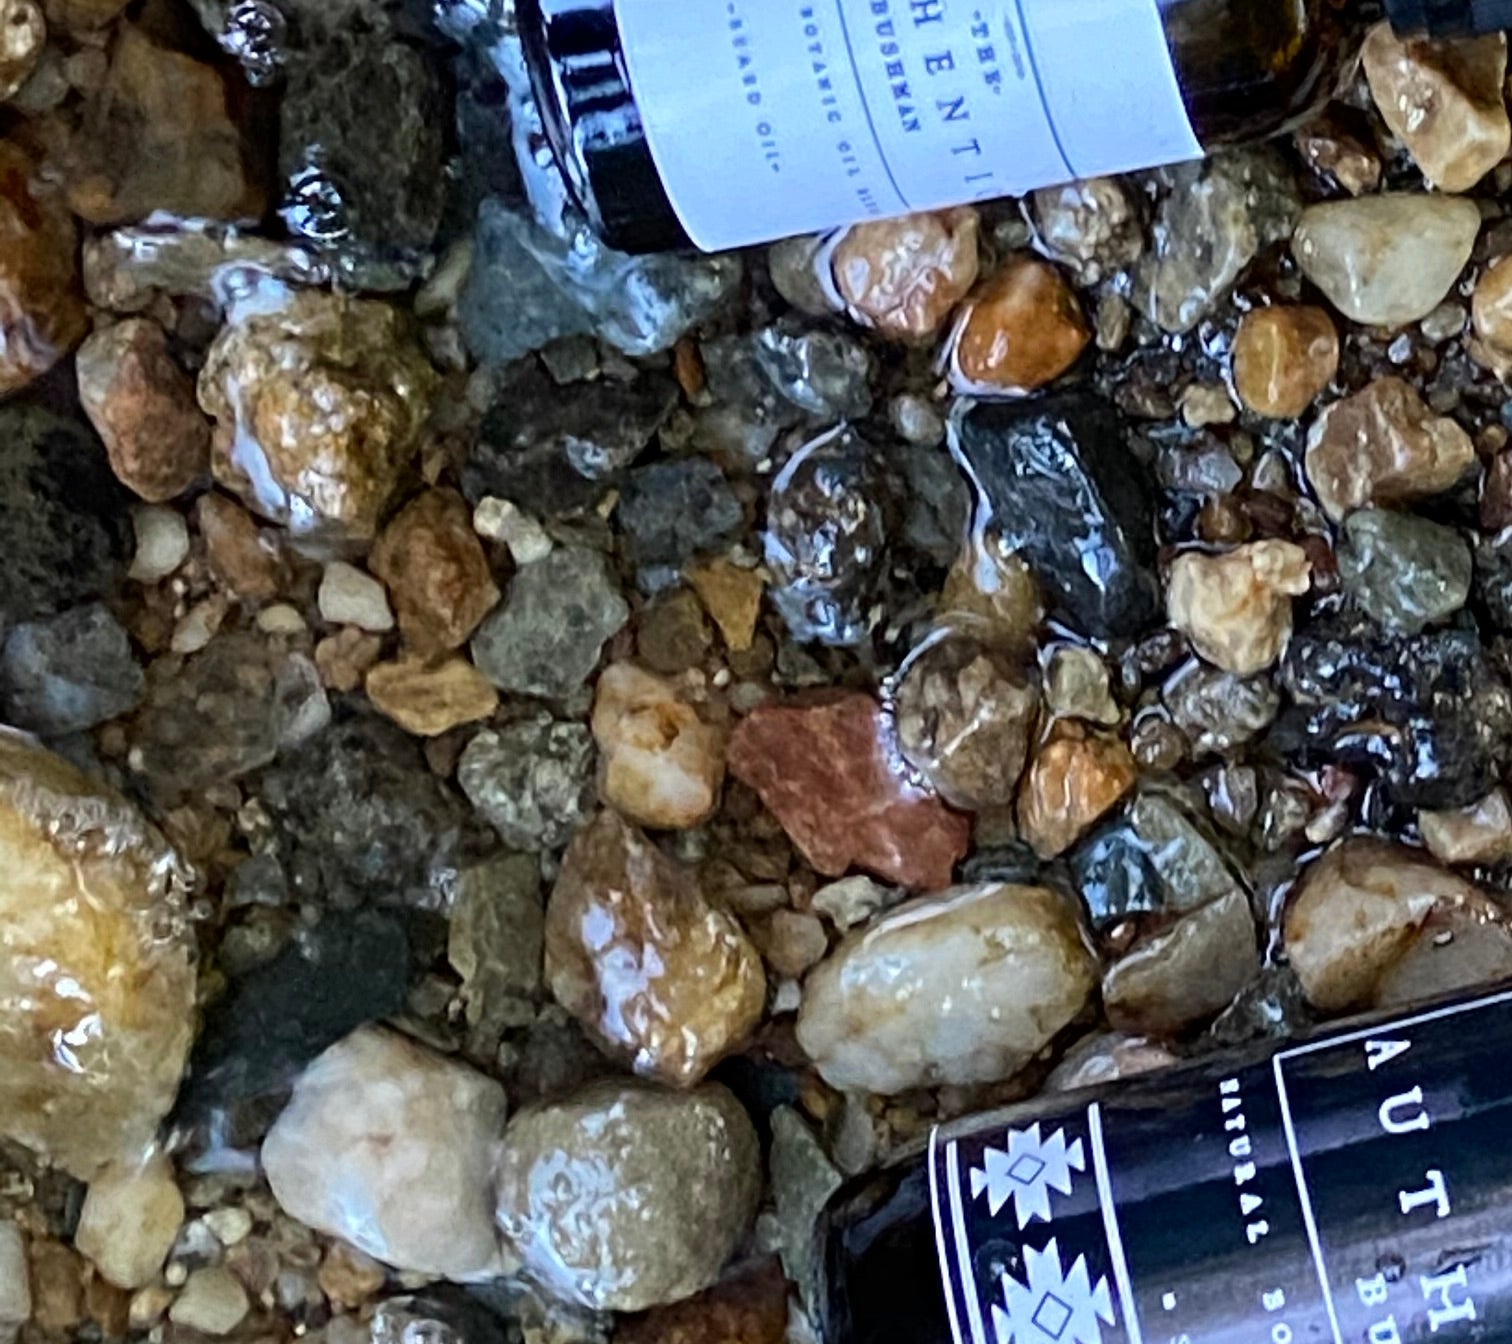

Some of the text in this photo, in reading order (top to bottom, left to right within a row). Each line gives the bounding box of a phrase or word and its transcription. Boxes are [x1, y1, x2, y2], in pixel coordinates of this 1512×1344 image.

[800, 7, 842, 124] BOTANIC
[838, 141, 860, 179] OIL
[1219, 1077, 1270, 1245] NATURAL
